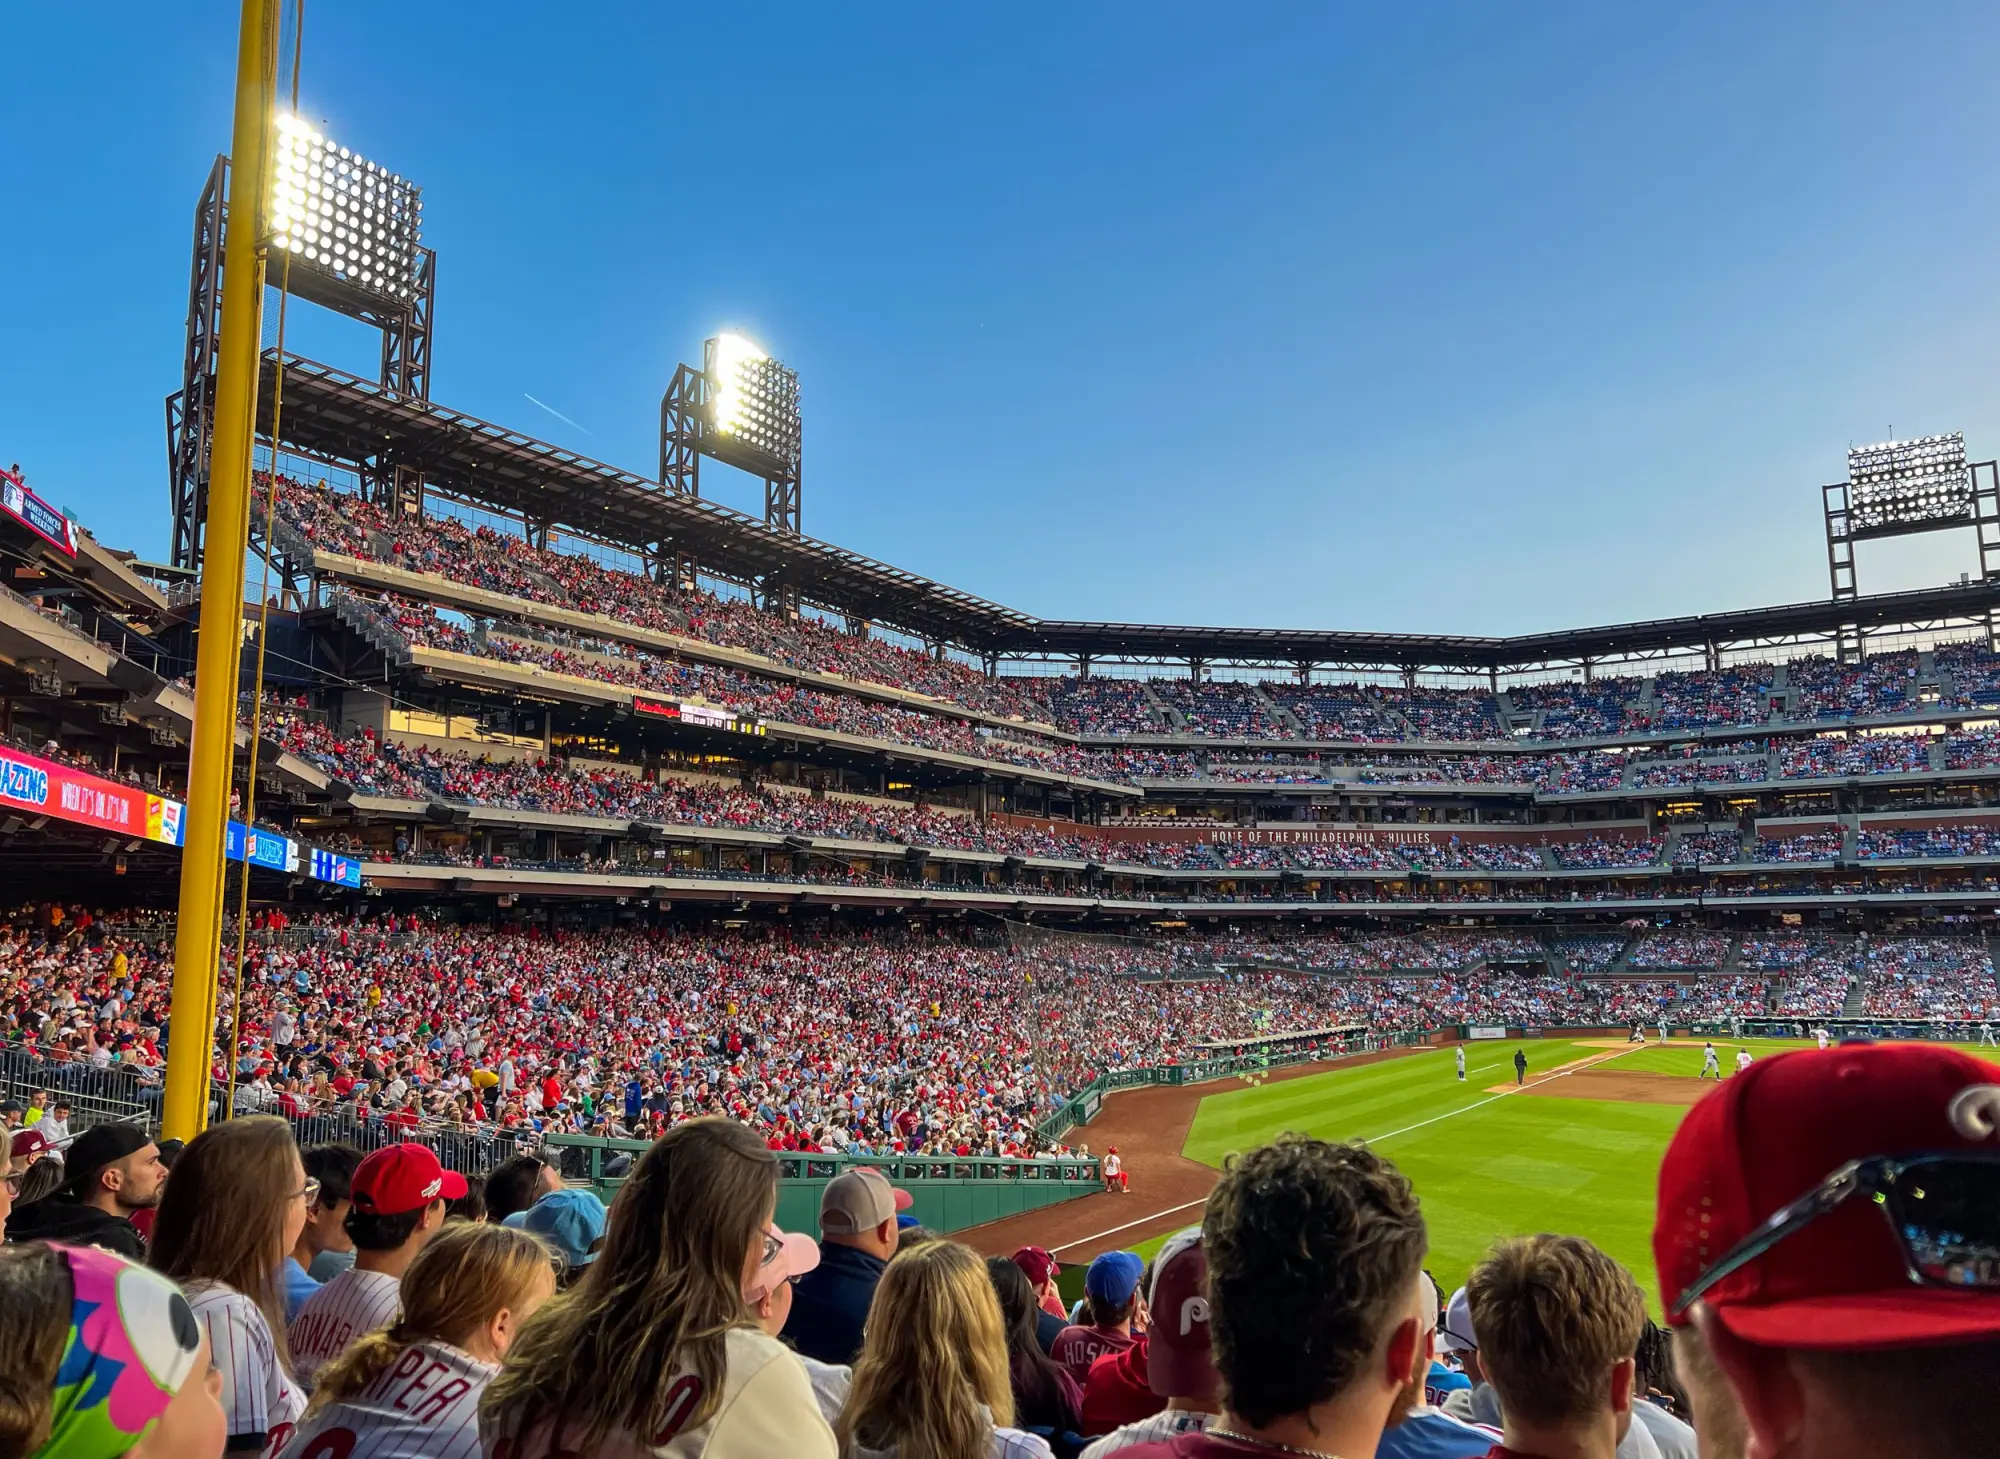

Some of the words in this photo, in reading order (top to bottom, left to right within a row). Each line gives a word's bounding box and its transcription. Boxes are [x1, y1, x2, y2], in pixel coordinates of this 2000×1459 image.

[24, 499, 43, 517] ARMED
[43, 512, 61, 531] FORCES
[30, 511, 55, 536] WEEKEND
[62, 781, 81, 811] WHEN
[81, 787, 95, 816] IT'S
[106, 793, 120, 822] IT'S
[120, 799, 130, 825] ON
[1249, 831, 1262, 842] OF
[1268, 831, 1288, 842] THE
[1295, 831, 1375, 843] PHILADELPHIA
[1387, 832, 1430, 844] HILLIES
[1180, 1296, 1210, 1336] P
[288, 1313, 352, 1360] HOWAR
[1064, 1340, 1118, 1367] HOSK
